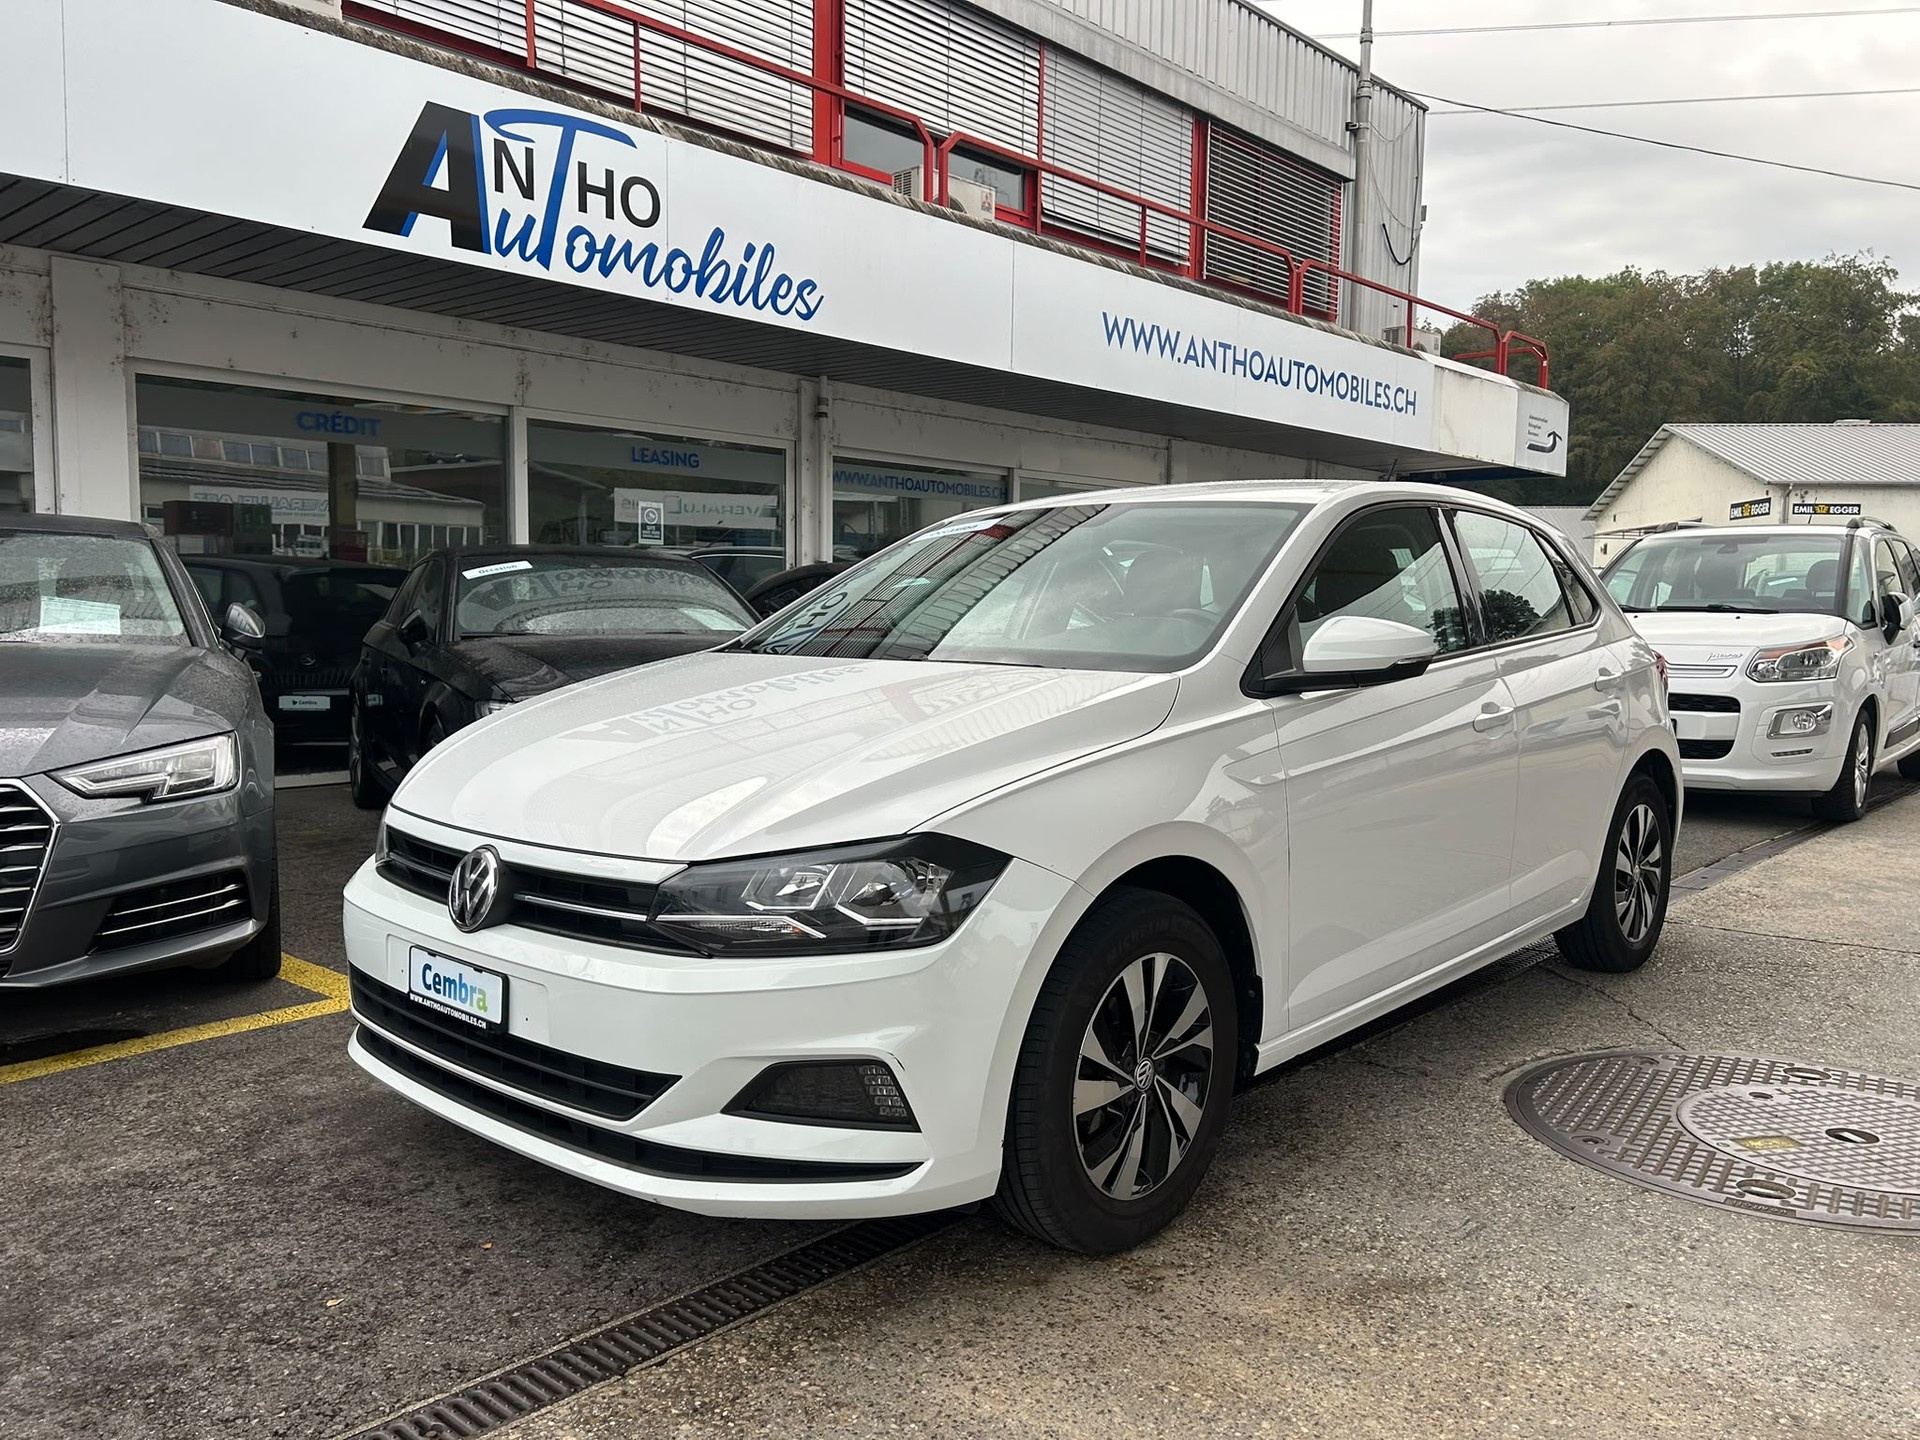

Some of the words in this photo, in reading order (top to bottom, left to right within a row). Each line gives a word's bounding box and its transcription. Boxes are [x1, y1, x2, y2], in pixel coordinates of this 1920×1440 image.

[1102, 311, 1417, 416] WWW.ANTHOAUTOMOBILES.CH
[296, 410, 382, 437] CRÉDIT
[631, 446, 700, 468] LEASING
[1730, 507, 1742, 519] EMIL
[1751, 502, 1769, 516] EGGER
[1794, 504, 1814, 513] EMIL
[1829, 505, 1859, 514] EGGER
[422, 963, 488, 1012] Cembra
[409, 993, 487, 1029] WWW.ANTHOAUTOMOBILES.CH
